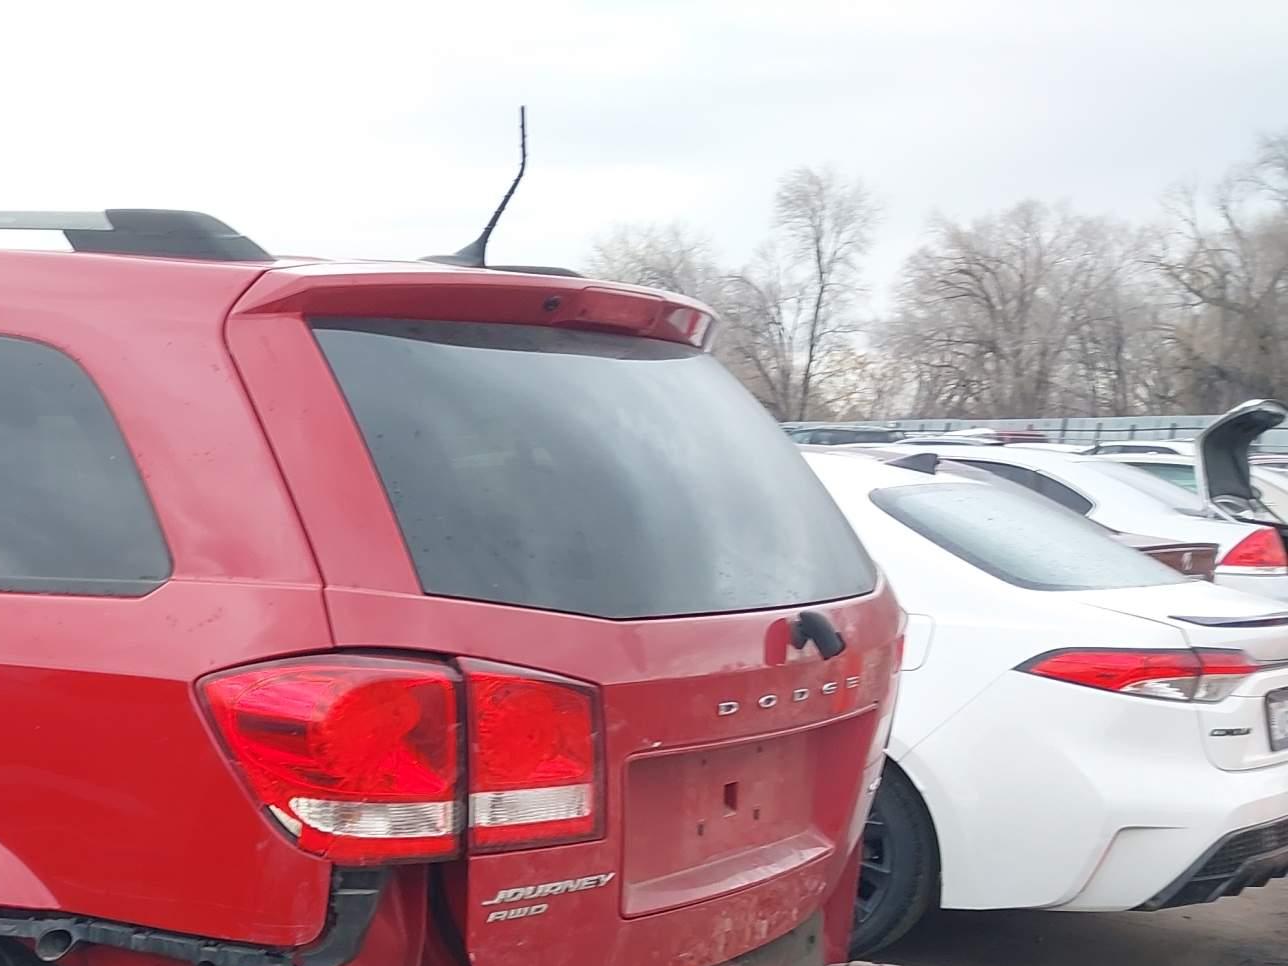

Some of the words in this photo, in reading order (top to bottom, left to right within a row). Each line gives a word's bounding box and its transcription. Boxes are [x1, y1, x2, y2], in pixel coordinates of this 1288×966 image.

[717, 676, 861, 716] DODGE
[480, 872, 617, 906] JOURNEY
[486, 903, 549, 923] AWD
